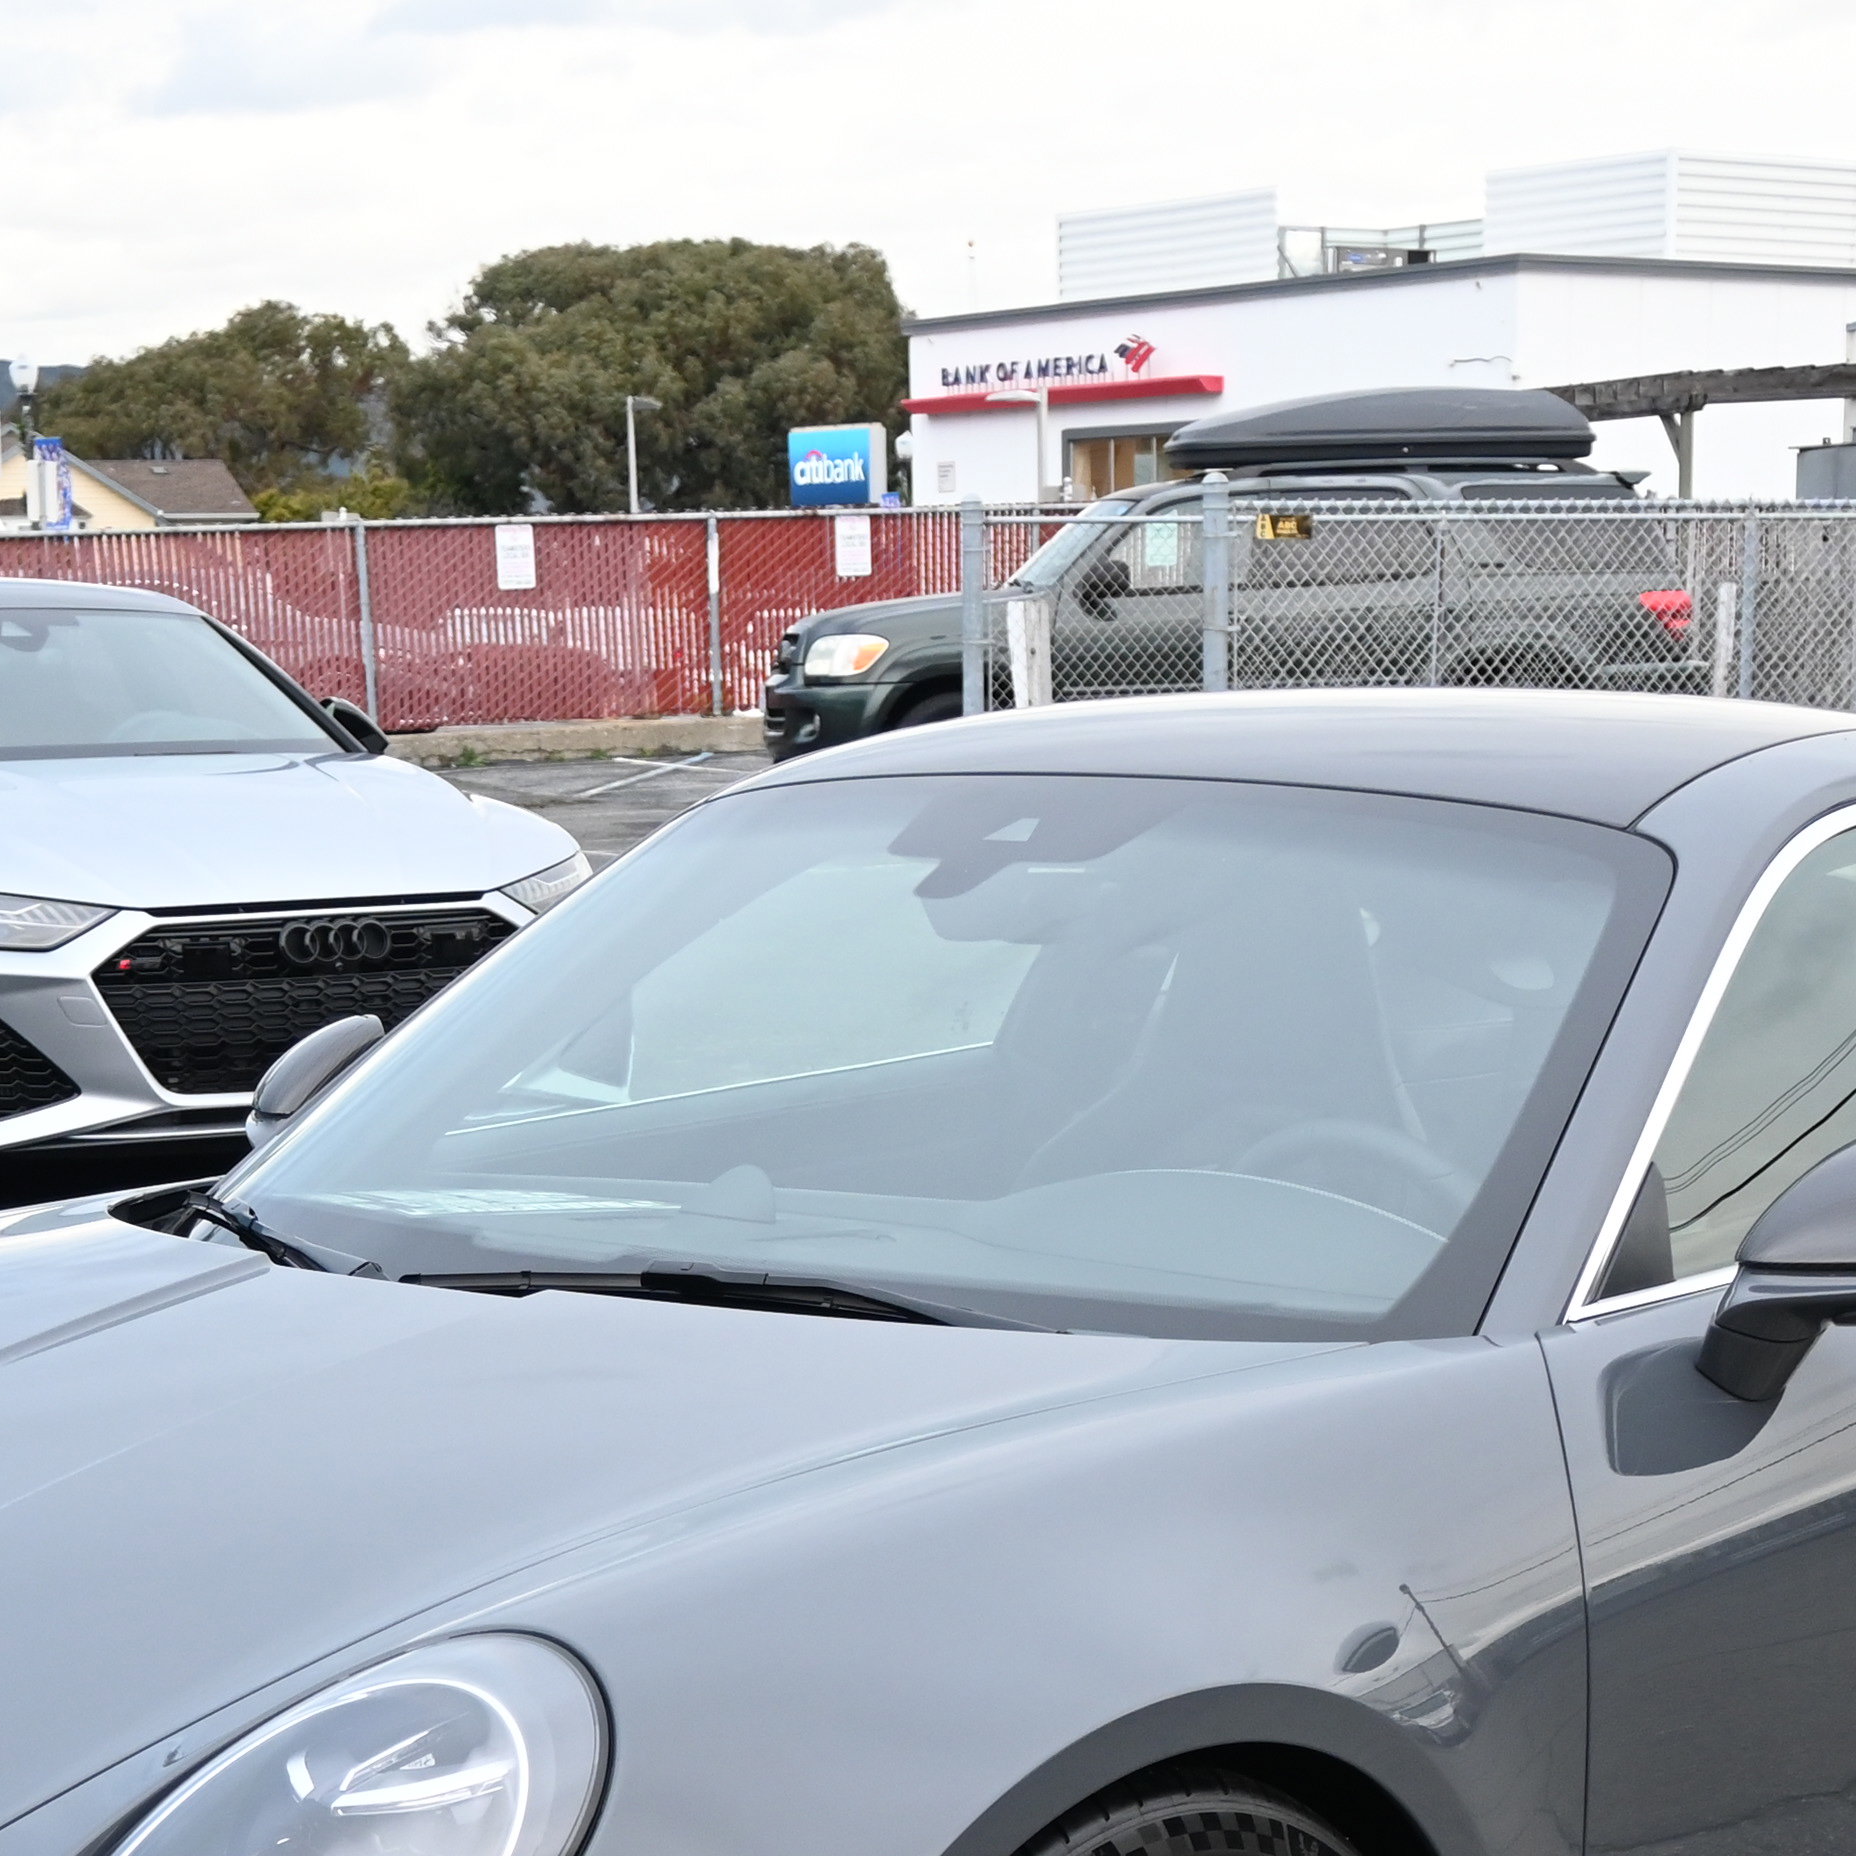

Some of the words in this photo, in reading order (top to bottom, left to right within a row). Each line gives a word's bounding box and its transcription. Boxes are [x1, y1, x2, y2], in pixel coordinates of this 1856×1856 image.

[941, 363, 992, 387] BANK
[996, 360, 1019, 382] OF
[1024, 353, 1109, 380] AMERICA
[794, 452, 865, 486] citibank
